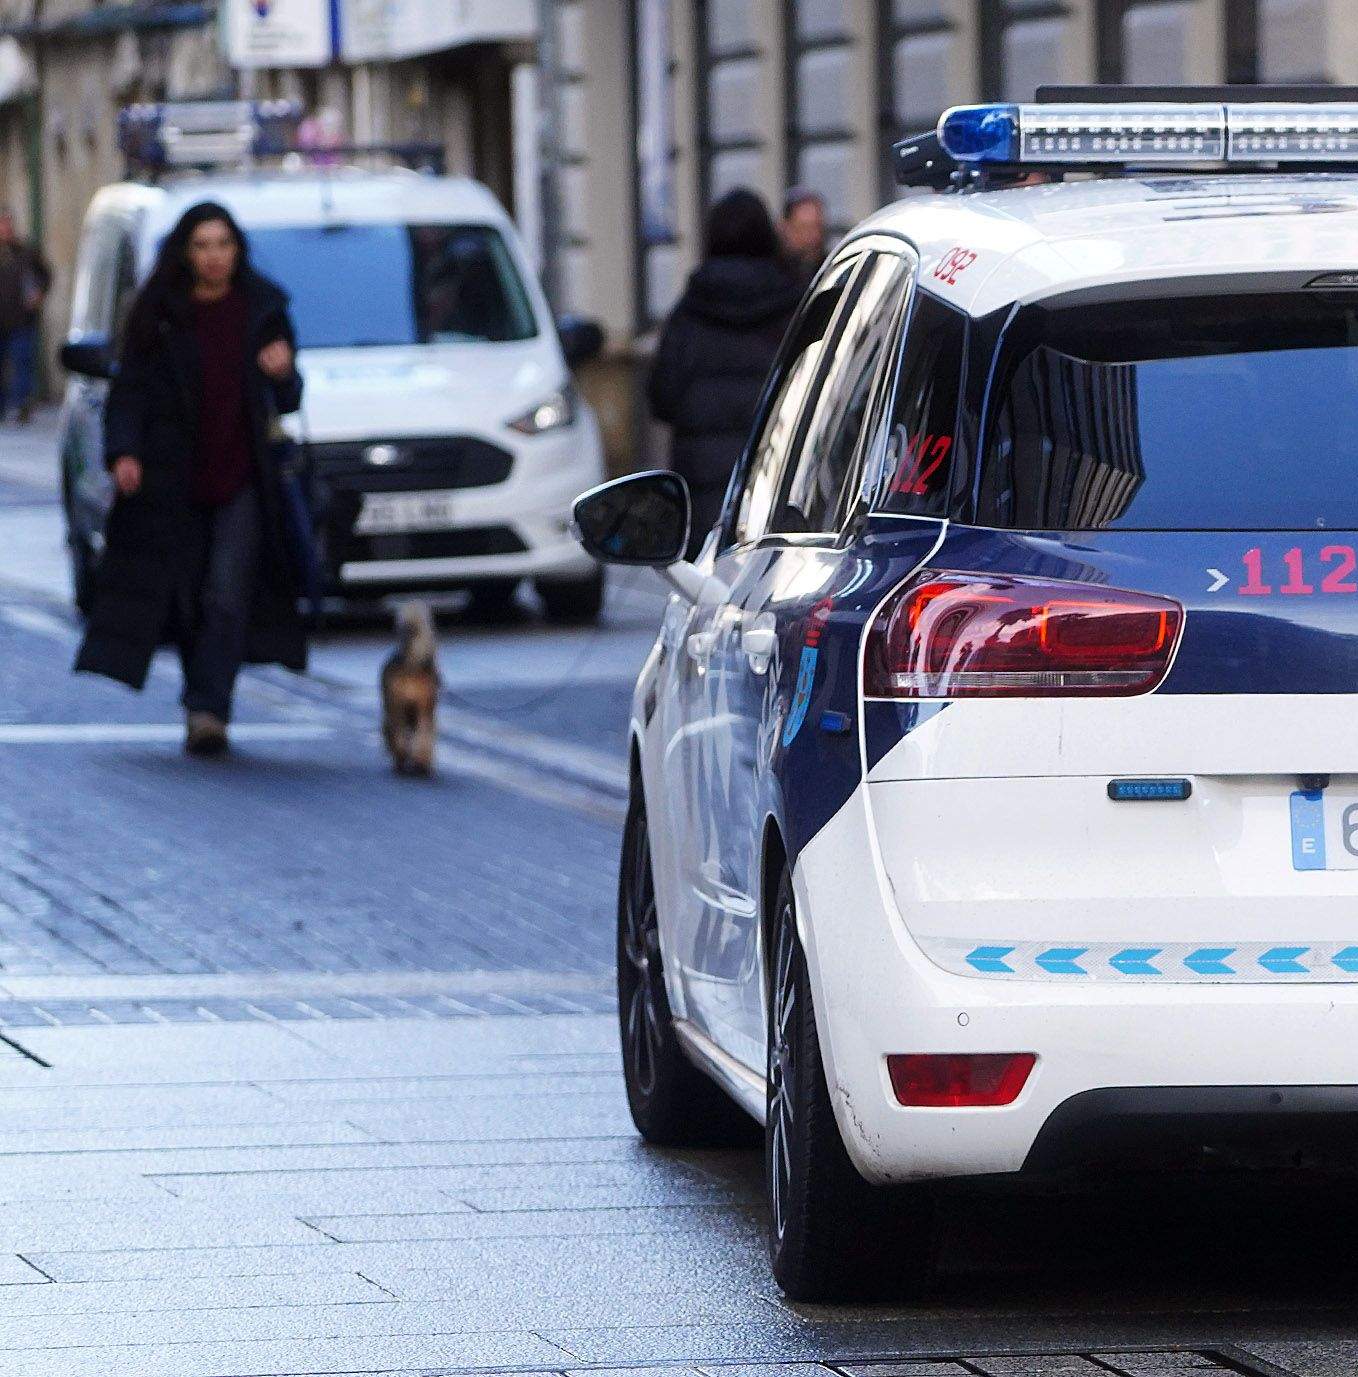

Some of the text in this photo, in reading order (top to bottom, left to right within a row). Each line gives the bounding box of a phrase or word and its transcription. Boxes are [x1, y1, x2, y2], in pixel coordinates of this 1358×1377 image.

[934, 247, 977, 285] 092
[1238, 545, 1358, 595] 112
[1302, 838, 1316, 854] E
